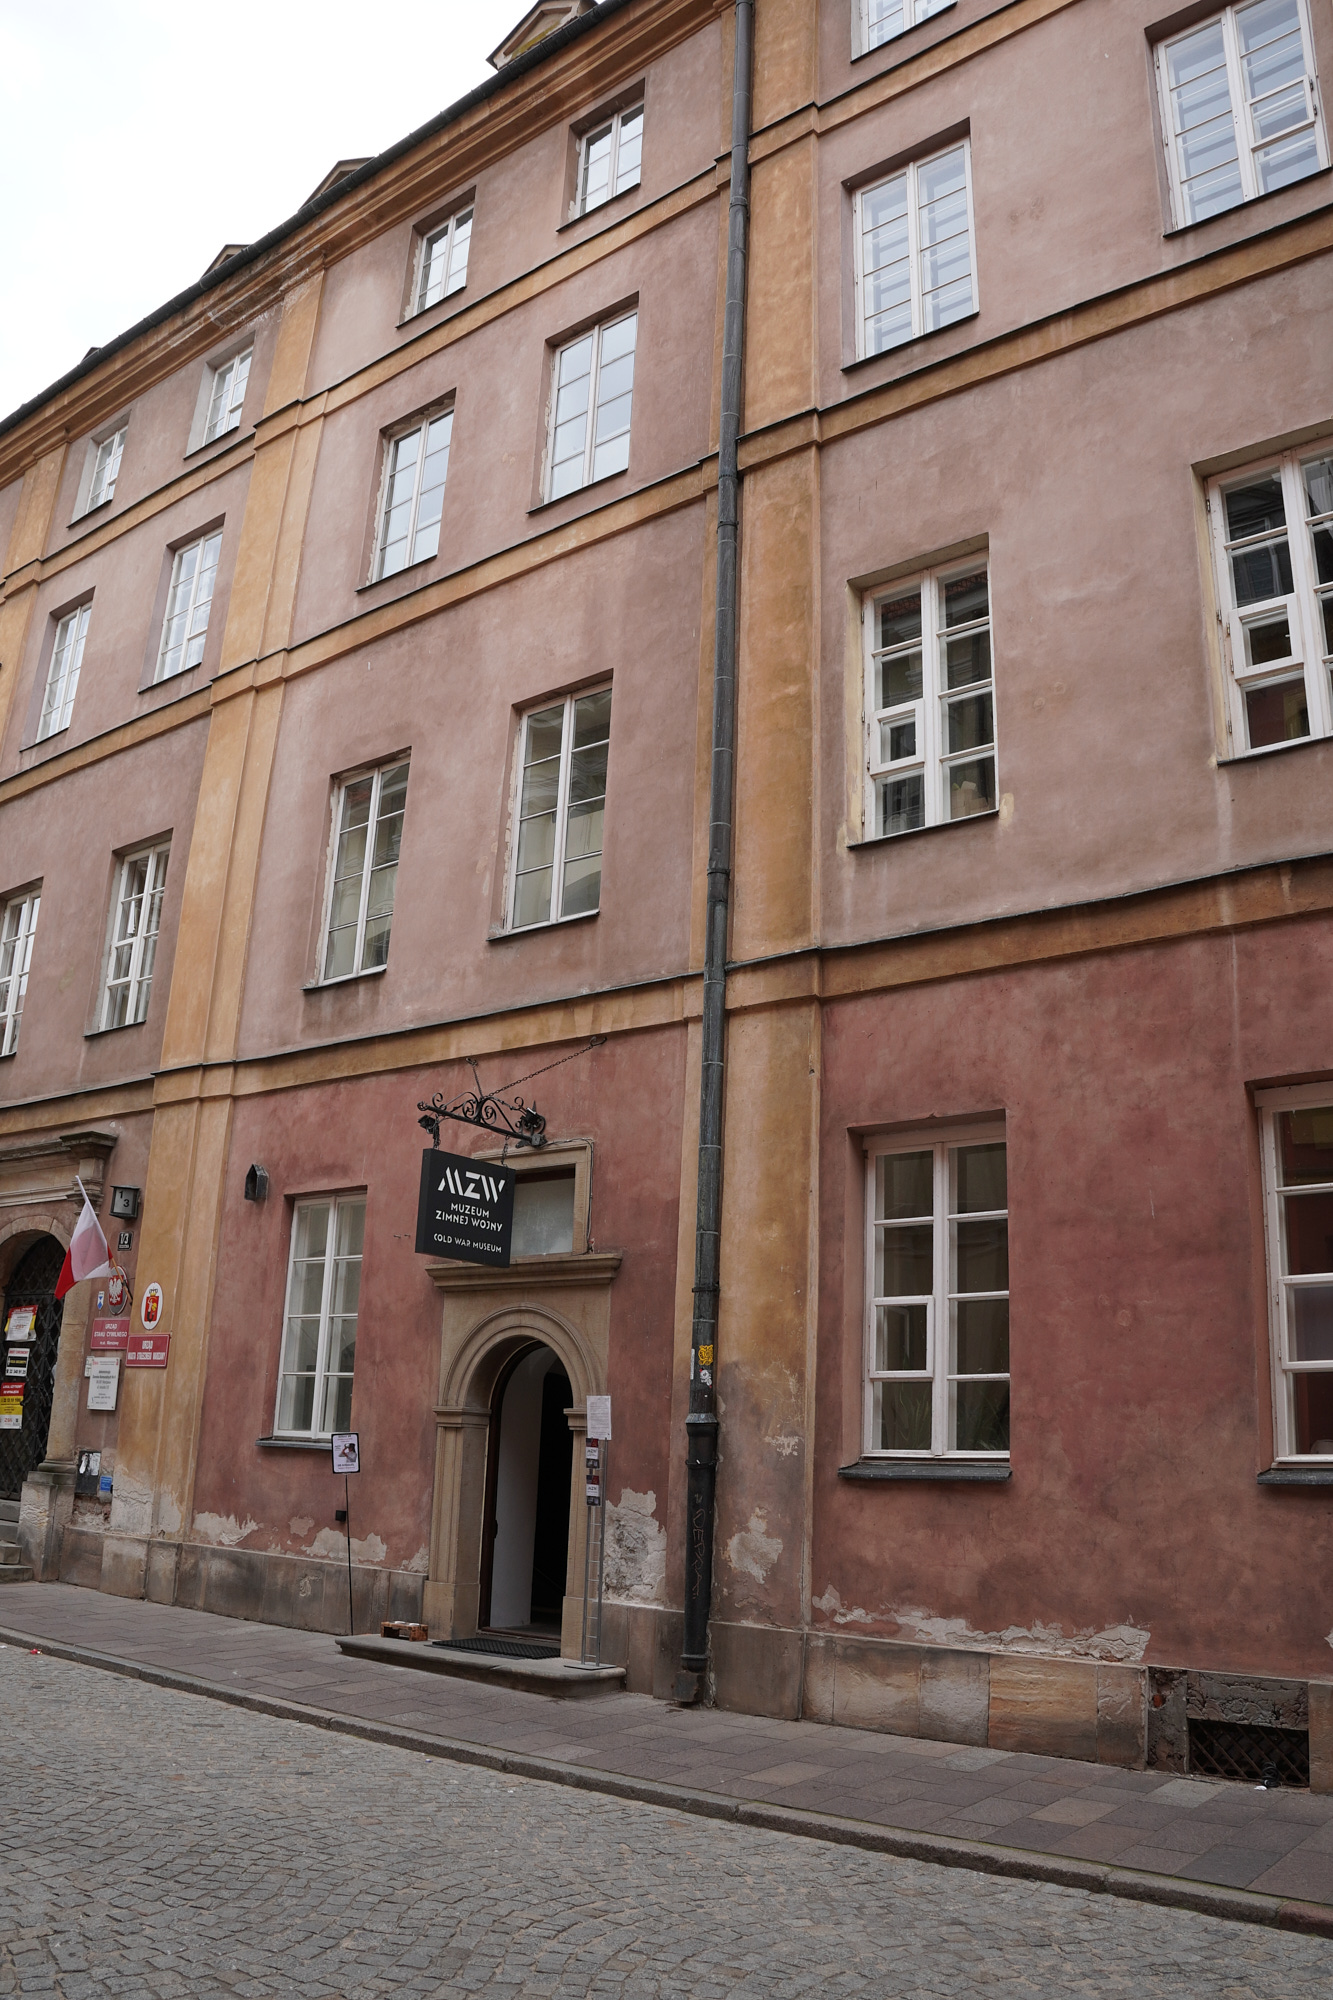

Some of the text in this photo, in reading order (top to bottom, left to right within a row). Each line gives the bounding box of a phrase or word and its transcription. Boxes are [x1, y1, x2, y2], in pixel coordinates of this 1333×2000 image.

[119, 1190, 124, 1199] 1
[437, 1166, 506, 1204] MZW
[123, 1199, 130, 1208] 3
[450, 1202, 490, 1219] MUZEUM
[435, 1209, 503, 1232] ZIMNEJ WOJNY
[433, 1233, 502, 1254] COLD WAR MUSEUM
